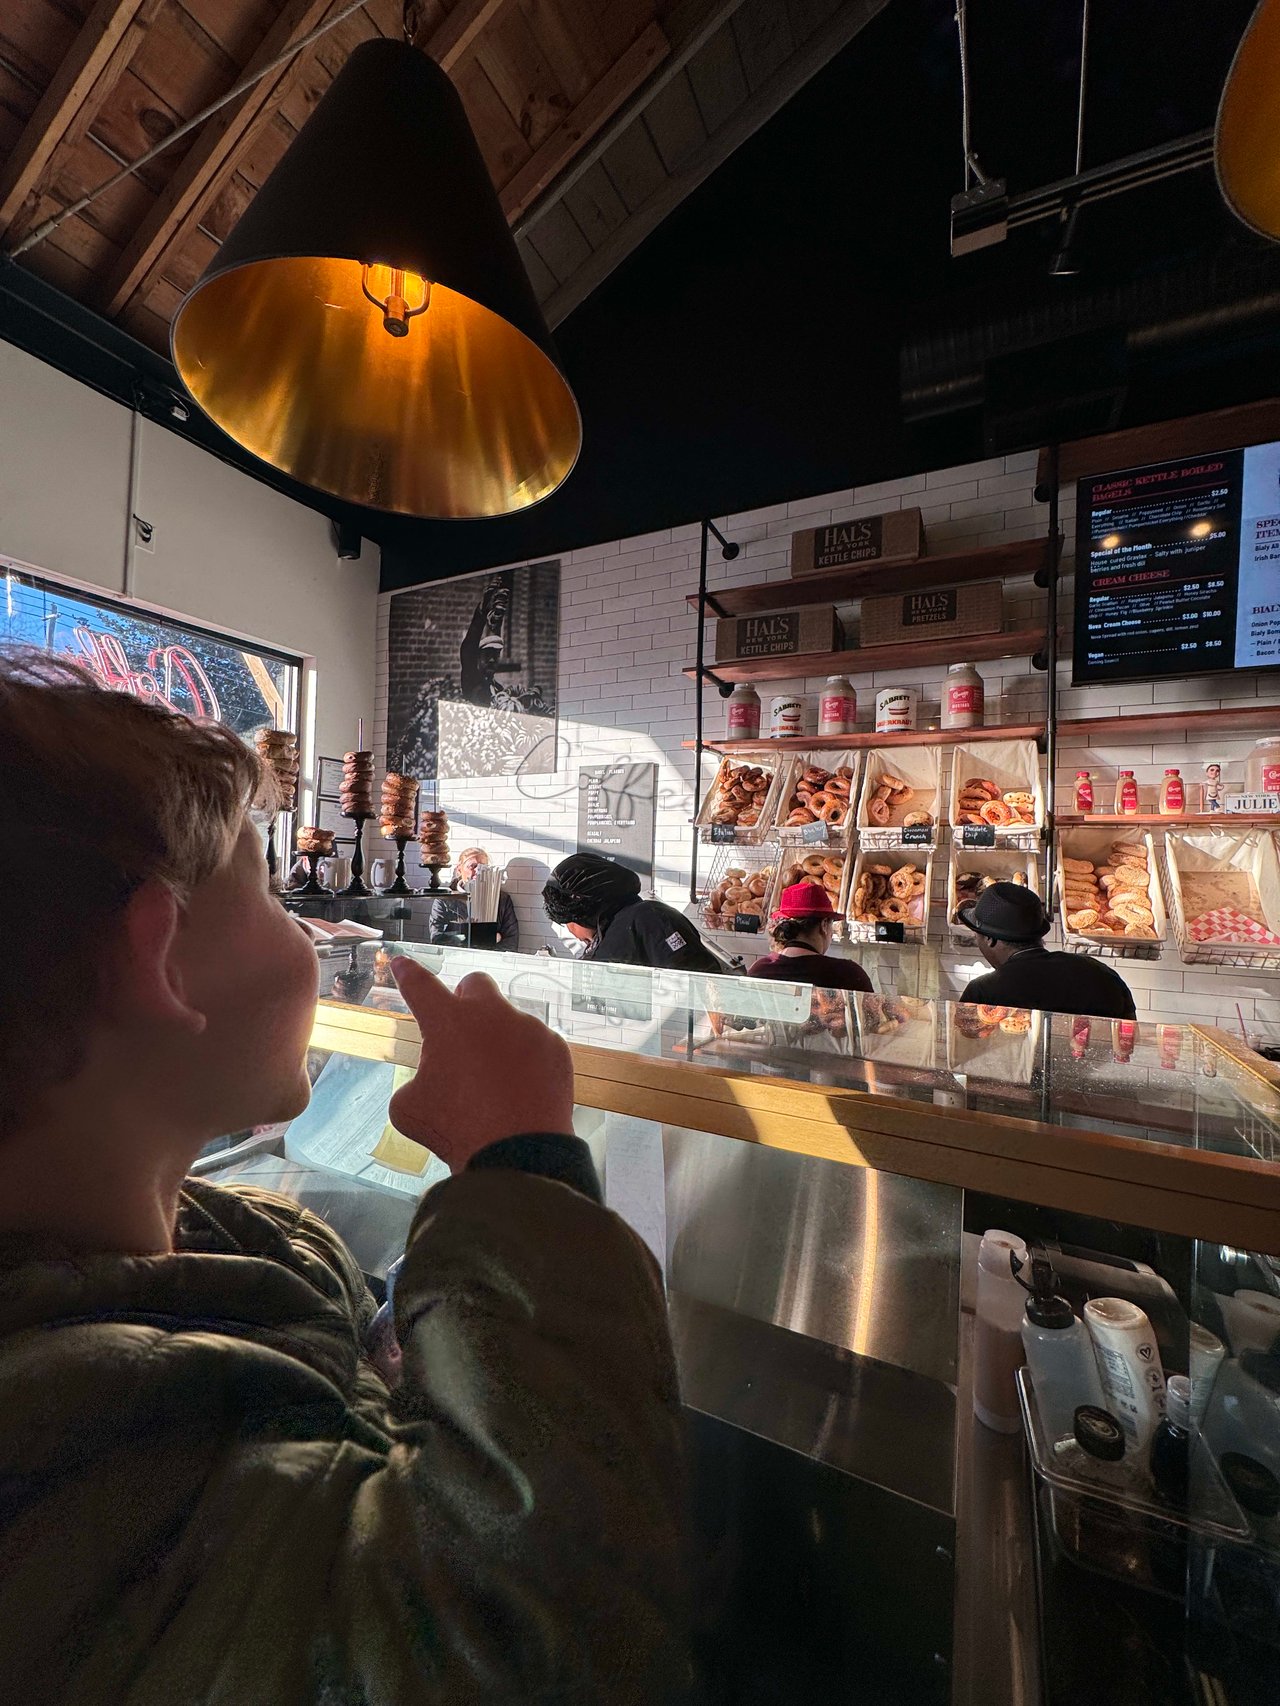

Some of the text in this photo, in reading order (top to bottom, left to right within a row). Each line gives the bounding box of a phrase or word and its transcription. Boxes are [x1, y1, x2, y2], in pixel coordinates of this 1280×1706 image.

[1092, 463, 1223, 493] CLASSIC KETTLE BOILED
[1092, 488, 1132, 501] BAGELS
[1091, 509, 1112, 517] Regular
[824, 522, 872, 547] HAL'S
[824, 540, 870, 553] NEW YORK
[1091, 549, 1113, 558] Special
[1121, 546, 1132, 554] the
[1133, 543, 1152, 552] Month
[818, 546, 877, 566] KETTLE CHIPS
[1092, 569, 1171, 587] CREAM CHEESE
[911, 592, 948, 610] HAL'S
[1089, 595, 1110, 603] Regular
[912, 613, 946, 623] PRETZELS
[1121, 619, 1142, 627] Cheese
[746, 616, 790, 638] HAL'S
[766, 634, 788, 642] YORK
[740, 641, 794, 655] KETTLE CHIPS
[1087, 652, 1104, 660] Vegan
[773, 702, 802, 717] SABRETT
[880, 695, 911, 711] SABRETT
[1234, 798, 1278, 810] JULIE
